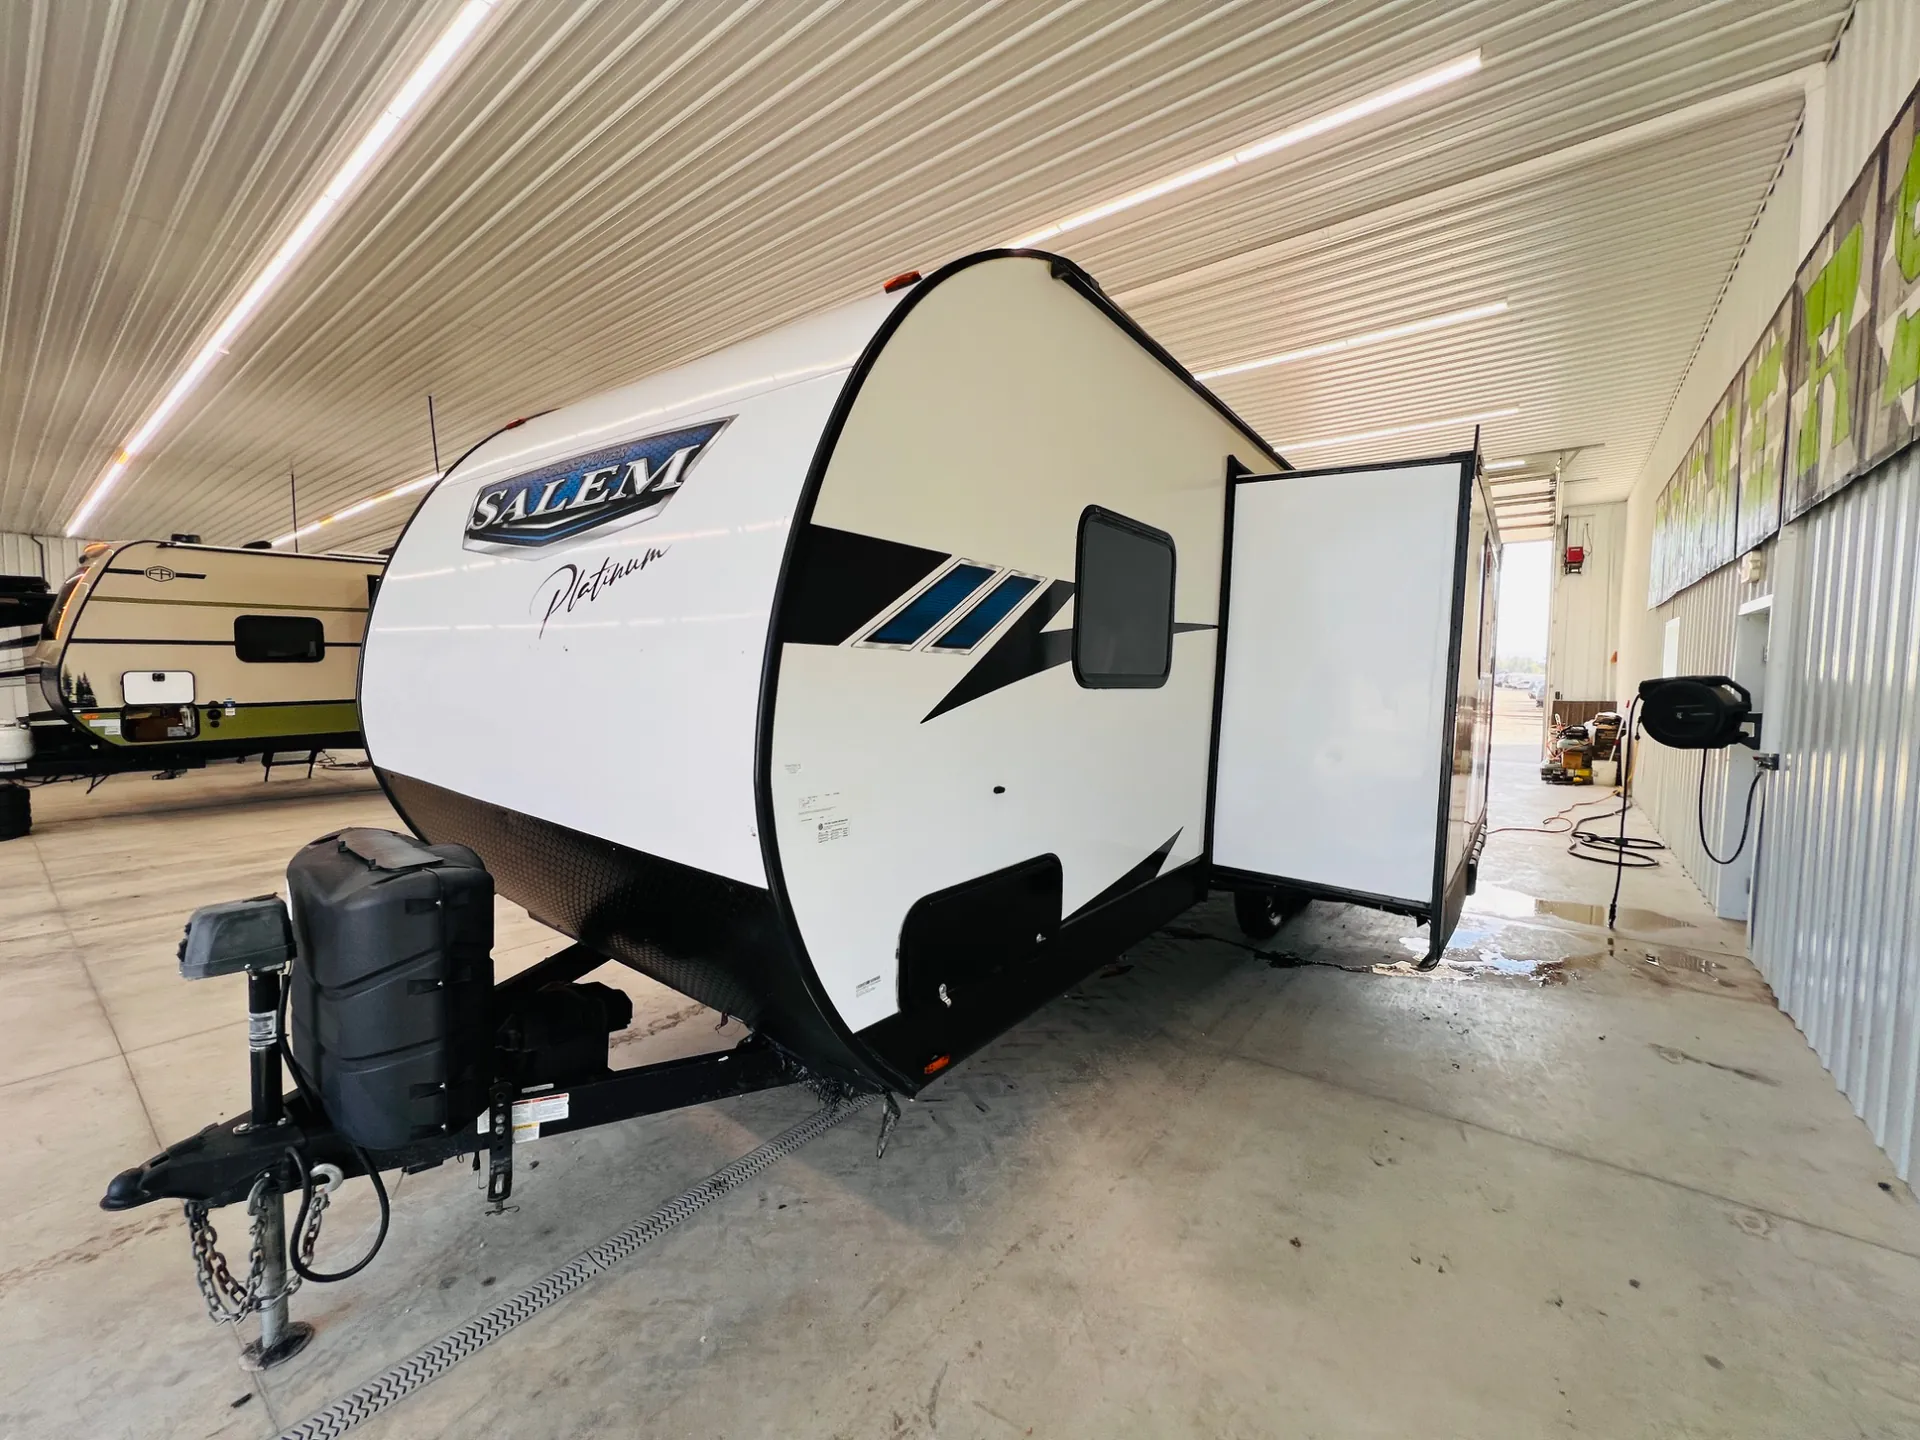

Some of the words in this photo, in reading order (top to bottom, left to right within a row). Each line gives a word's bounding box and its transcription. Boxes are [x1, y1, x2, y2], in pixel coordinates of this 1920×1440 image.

[467, 444, 701, 531] SALEM
[148, 567, 172, 580] FR
[529, 544, 672, 640] Platinum
